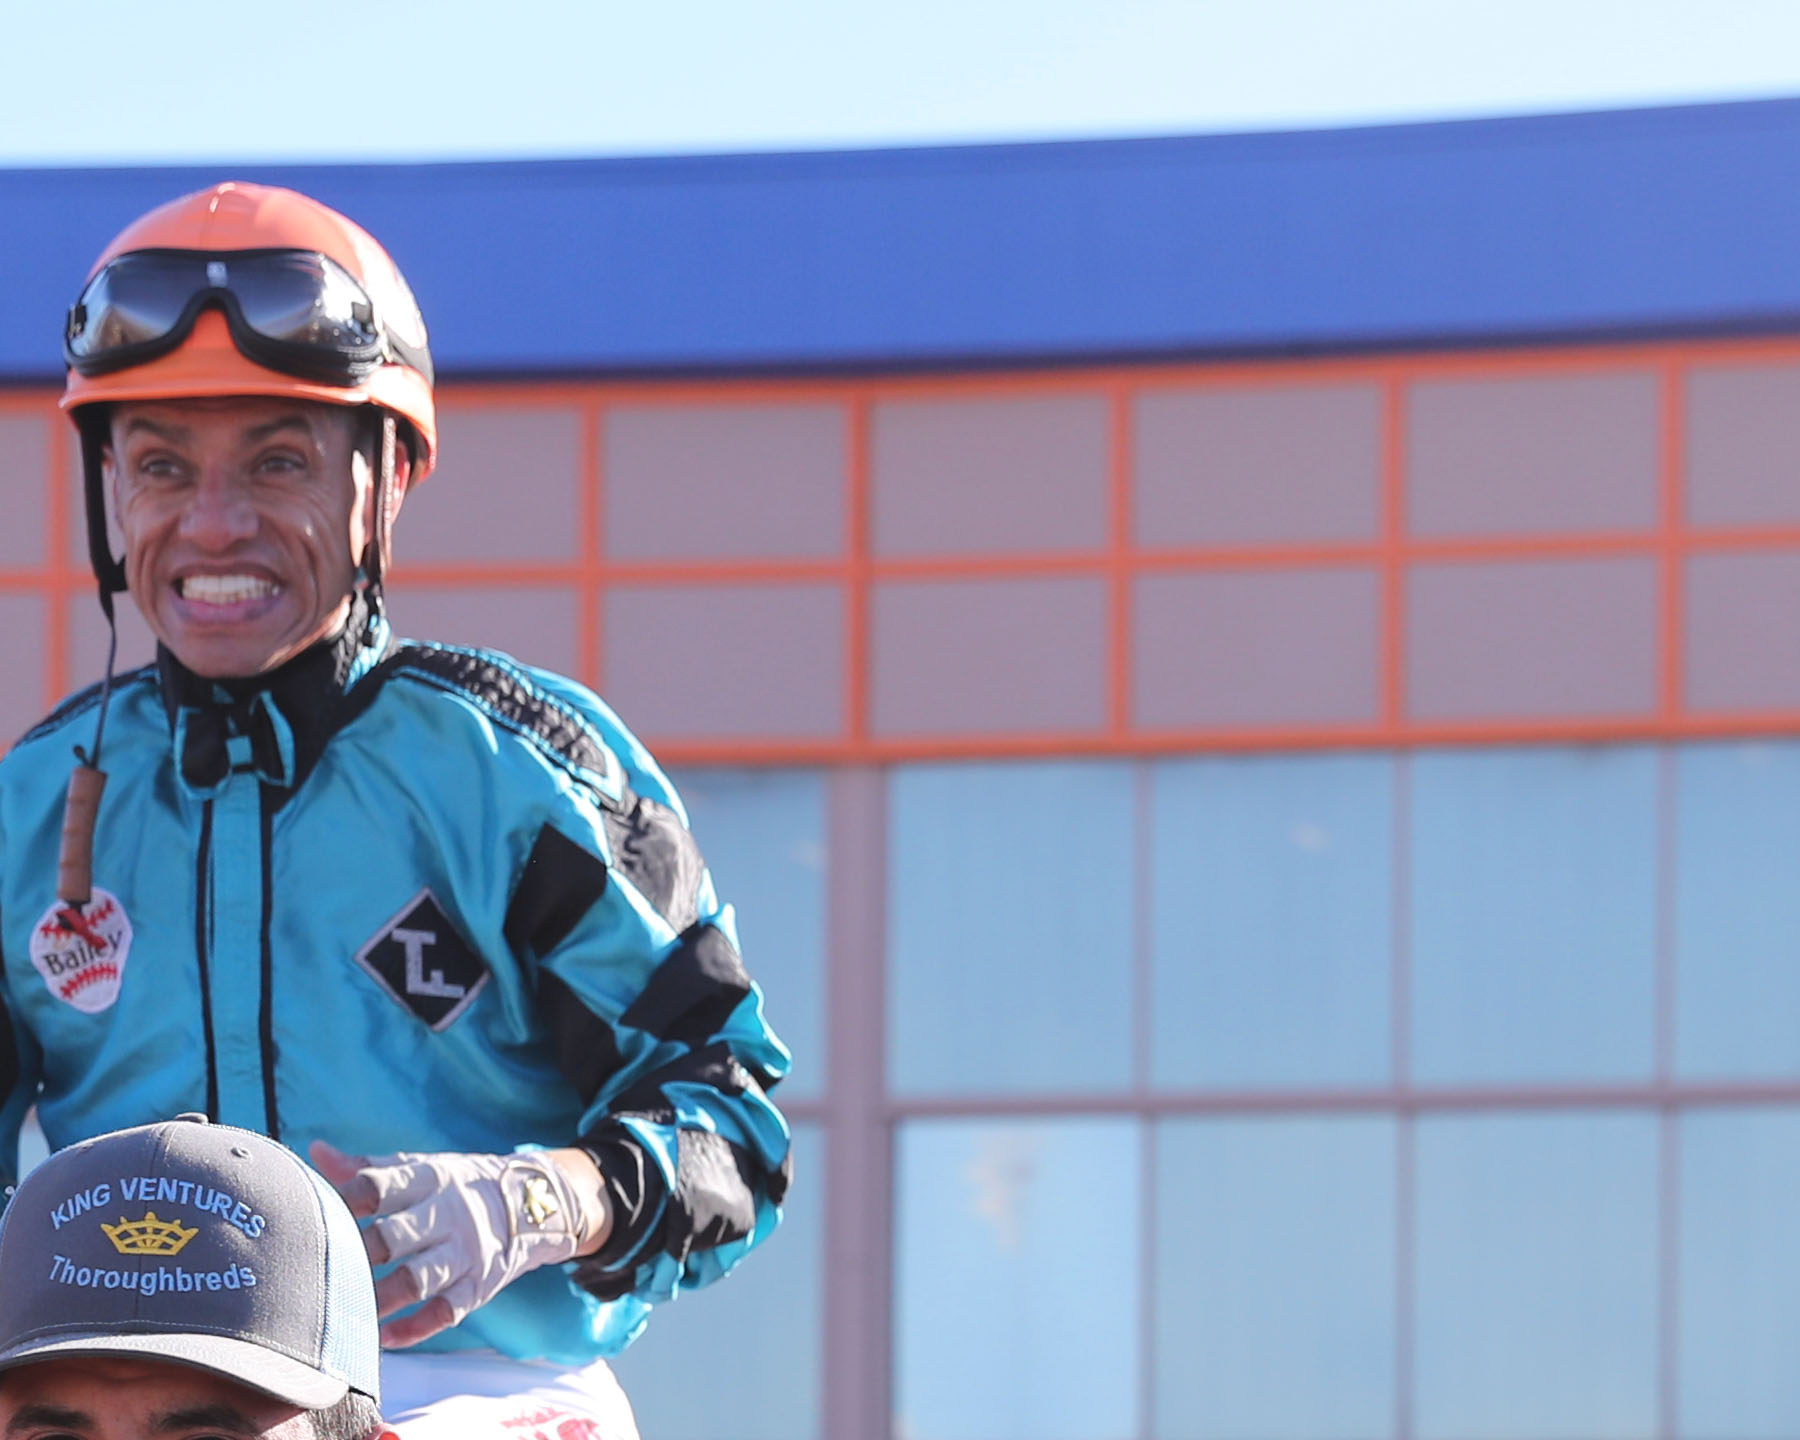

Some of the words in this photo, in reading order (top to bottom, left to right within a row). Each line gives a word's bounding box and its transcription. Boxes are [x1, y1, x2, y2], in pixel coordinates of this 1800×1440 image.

[51, 1184, 110, 1230] KING
[120, 1177, 266, 1239] VENTURES
[50, 1255, 257, 1296] Thoroughbreds
